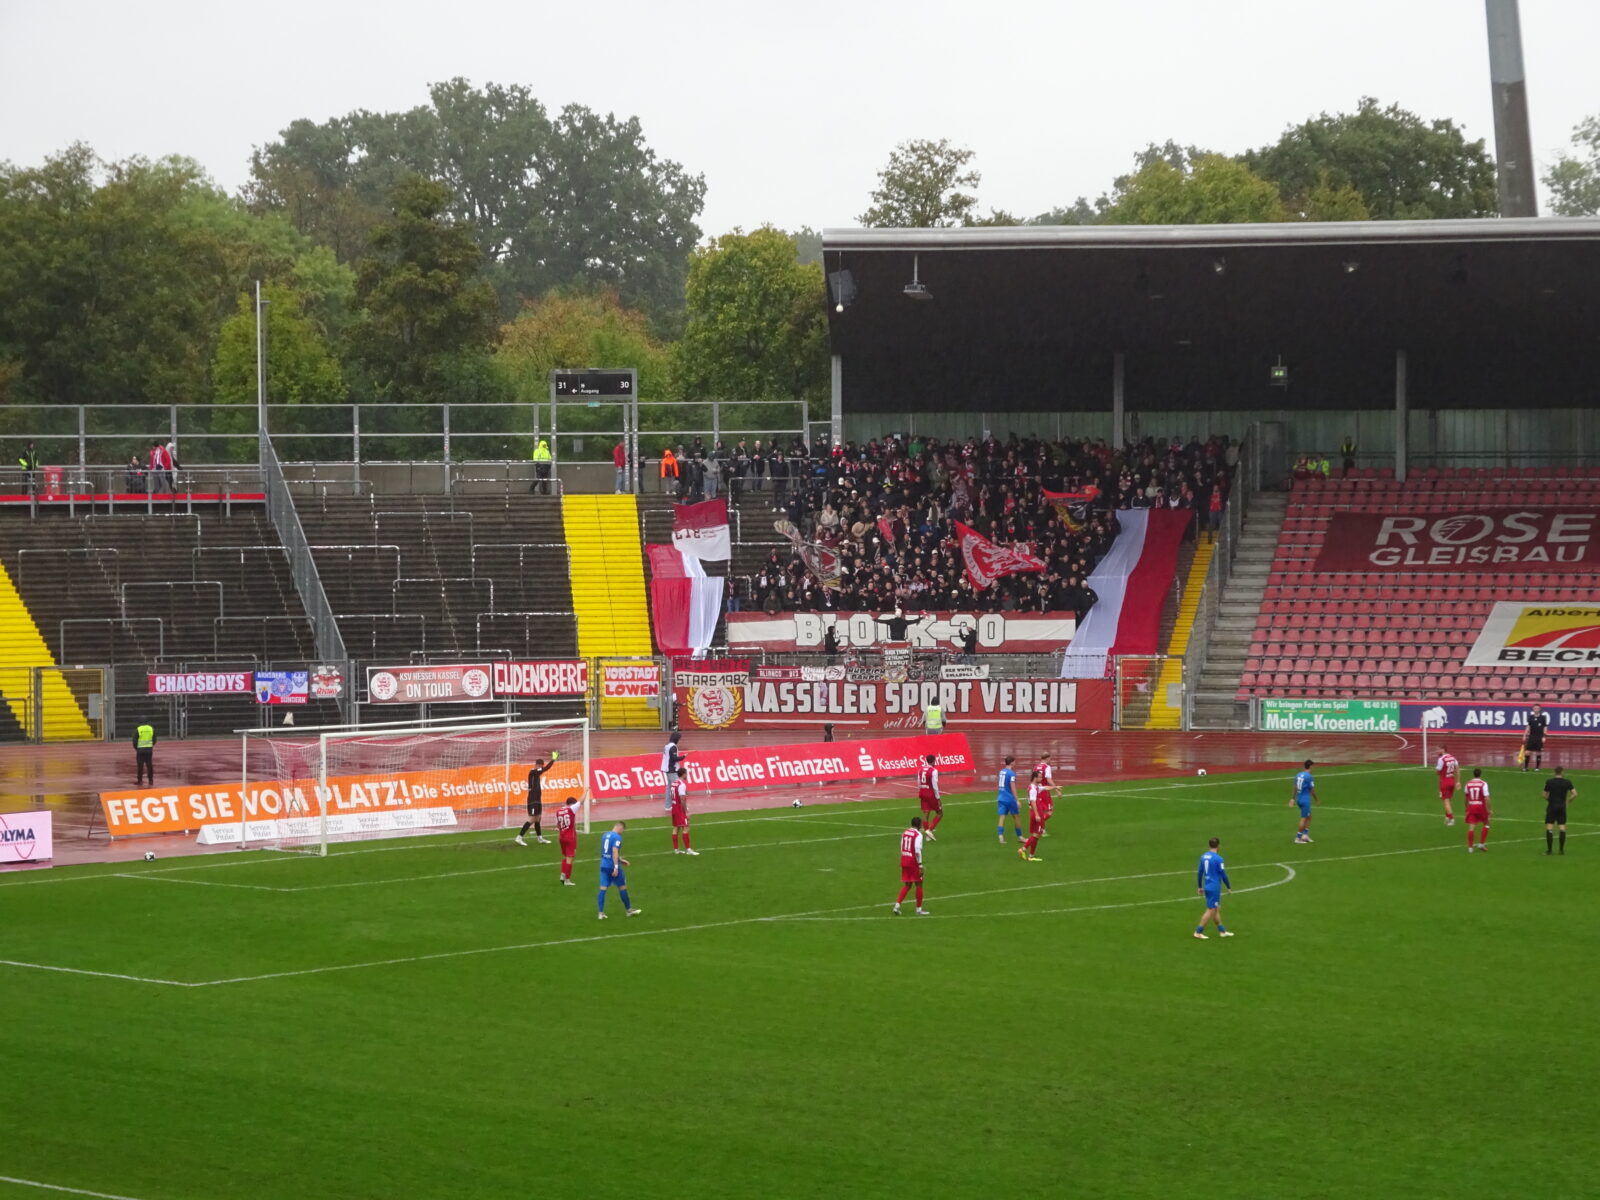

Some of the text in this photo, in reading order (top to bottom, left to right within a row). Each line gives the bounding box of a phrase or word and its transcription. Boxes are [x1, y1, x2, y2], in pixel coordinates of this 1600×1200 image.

[558, 381, 567, 389] 31
[620, 381, 630, 389] 30
[1375, 512, 1597, 546] ROSE
[1369, 545, 1586, 566] GLEISBAU
[400, 671, 461, 681] KSV HESSEN KASSEL
[494, 662, 588, 693] GUDENSBERG
[605, 666, 659, 680] VORSTADT
[677, 674, 717, 686] STARS
[155, 674, 245, 692] CHAOSBOYS
[406, 683, 421, 698] ON
[424, 682, 453, 697] TOUR
[744, 681, 877, 714] KASSELER
[886, 681, 972, 714] SPORT
[980, 680, 1077, 713] VEREIN
[1265, 712, 1397, 731] Maler-Kroenert.de
[1464, 710, 1506, 726] AHS
[1559, 711, 1600, 728] HOSP
[877, 753, 966, 770] Kasseler Srkasse
[594, 769, 632, 791] Das
[683, 761, 712, 784] für
[716, 757, 766, 782] deine
[766, 755, 850, 778] Finanzen.
[411, 772, 584, 799] Die Stadtreinige Kassel
[1469, 787, 1480, 800] 17
[107, 779, 412, 826] FEGT SIE VOM PLATZ!
[557, 814, 571, 829] 26
[903, 836, 912, 851] 11
